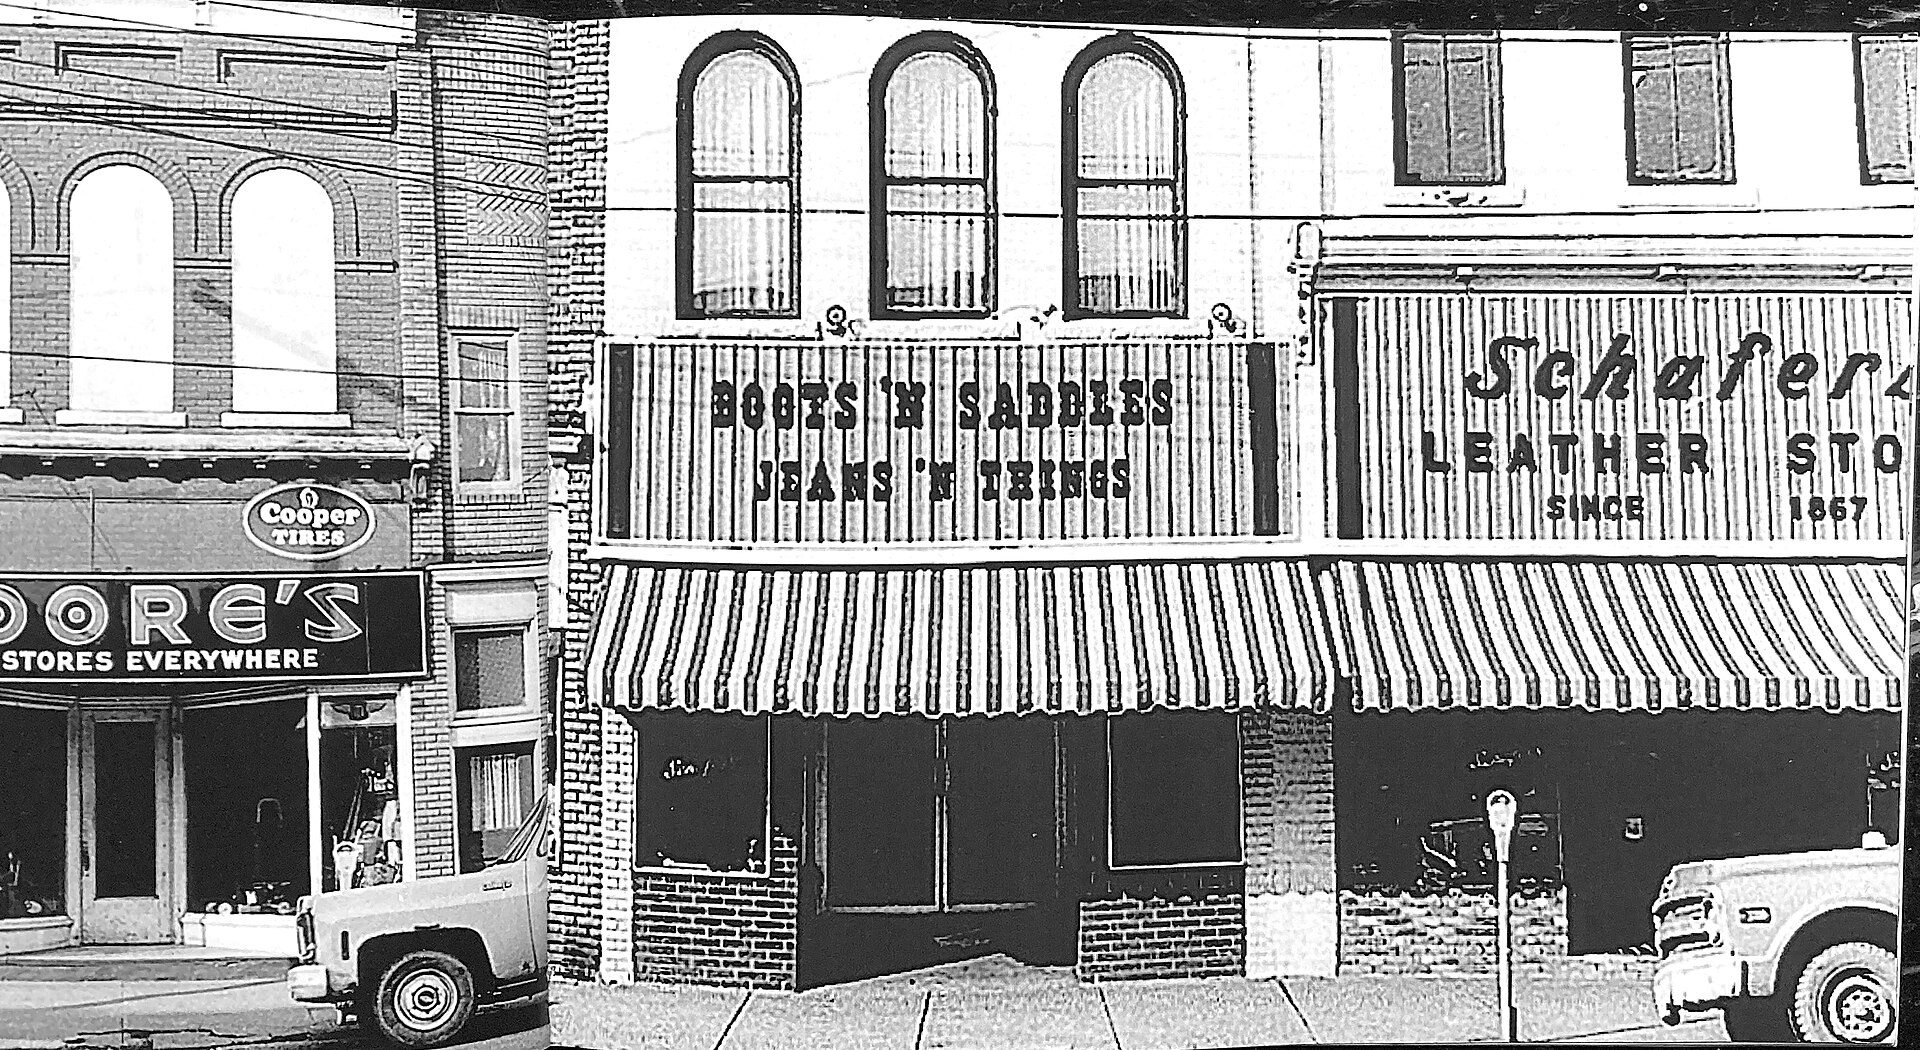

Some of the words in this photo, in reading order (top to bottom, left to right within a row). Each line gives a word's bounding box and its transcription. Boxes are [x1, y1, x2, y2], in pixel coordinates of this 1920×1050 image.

[711, 380, 858, 430] BOOTS
[958, 379, 1173, 428] SADDLES
[1421, 432, 1709, 474] LEATHER
[754, 460, 893, 501] JEANS
[979, 459, 1130, 500] THINGS
[259, 501, 361, 527] Cooper
[1547, 495, 1645, 522] SINCE
[1789, 496, 1868, 521] 1867
[271, 529, 345, 546] TIRES
[2, 650, 114, 672] STORES
[126, 648, 319, 671] EVERYWHERE
